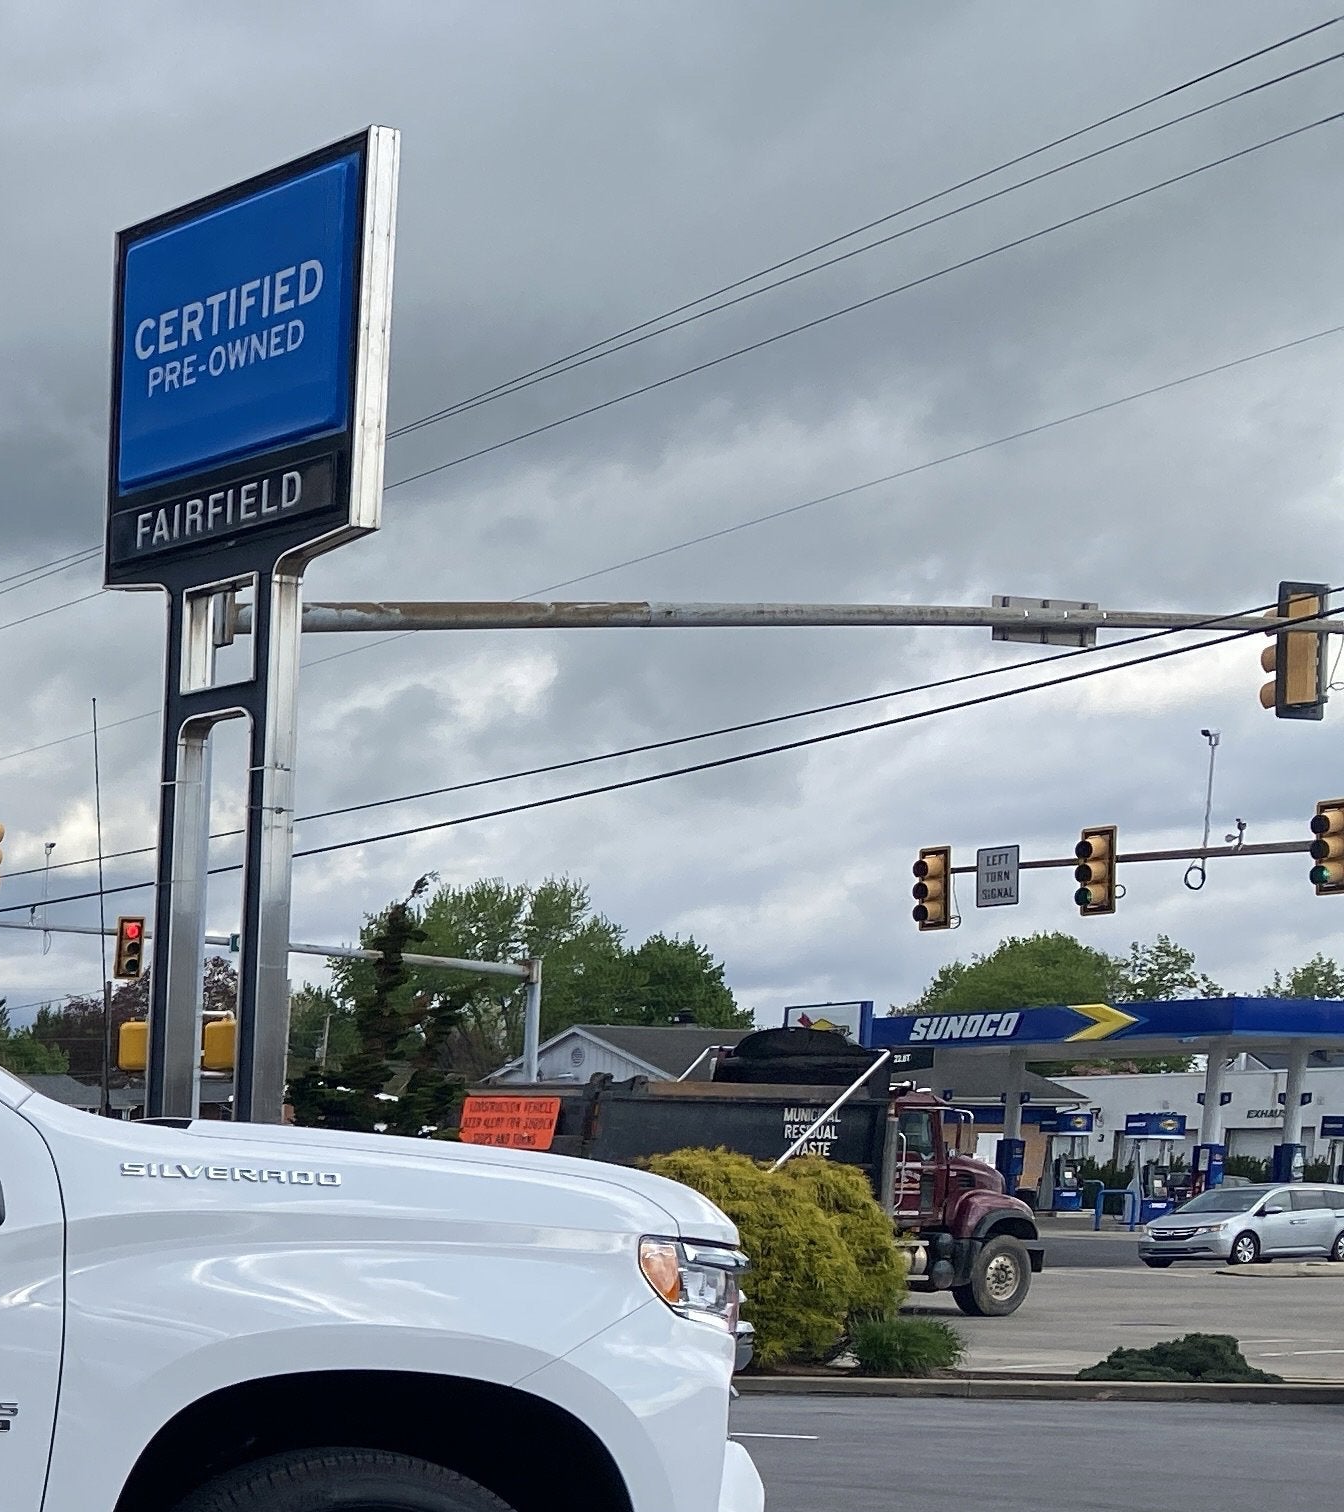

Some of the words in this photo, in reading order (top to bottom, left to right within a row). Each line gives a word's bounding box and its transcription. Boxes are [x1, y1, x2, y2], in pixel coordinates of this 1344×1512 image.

[134, 259, 324, 360] CERTIFIED
[147, 319, 305, 397] PRE-OWNED
[135, 470, 303, 550] FAIRFIELD
[986, 853, 1009, 867] LEFT
[984, 870, 1010, 883] TURN
[982, 886, 1015, 900] SIGNAL
[909, 1012, 1022, 1041] SUNOCO
[783, 1107, 842, 1123] MUNICIAL
[120, 1162, 342, 1187] SILVERADO
